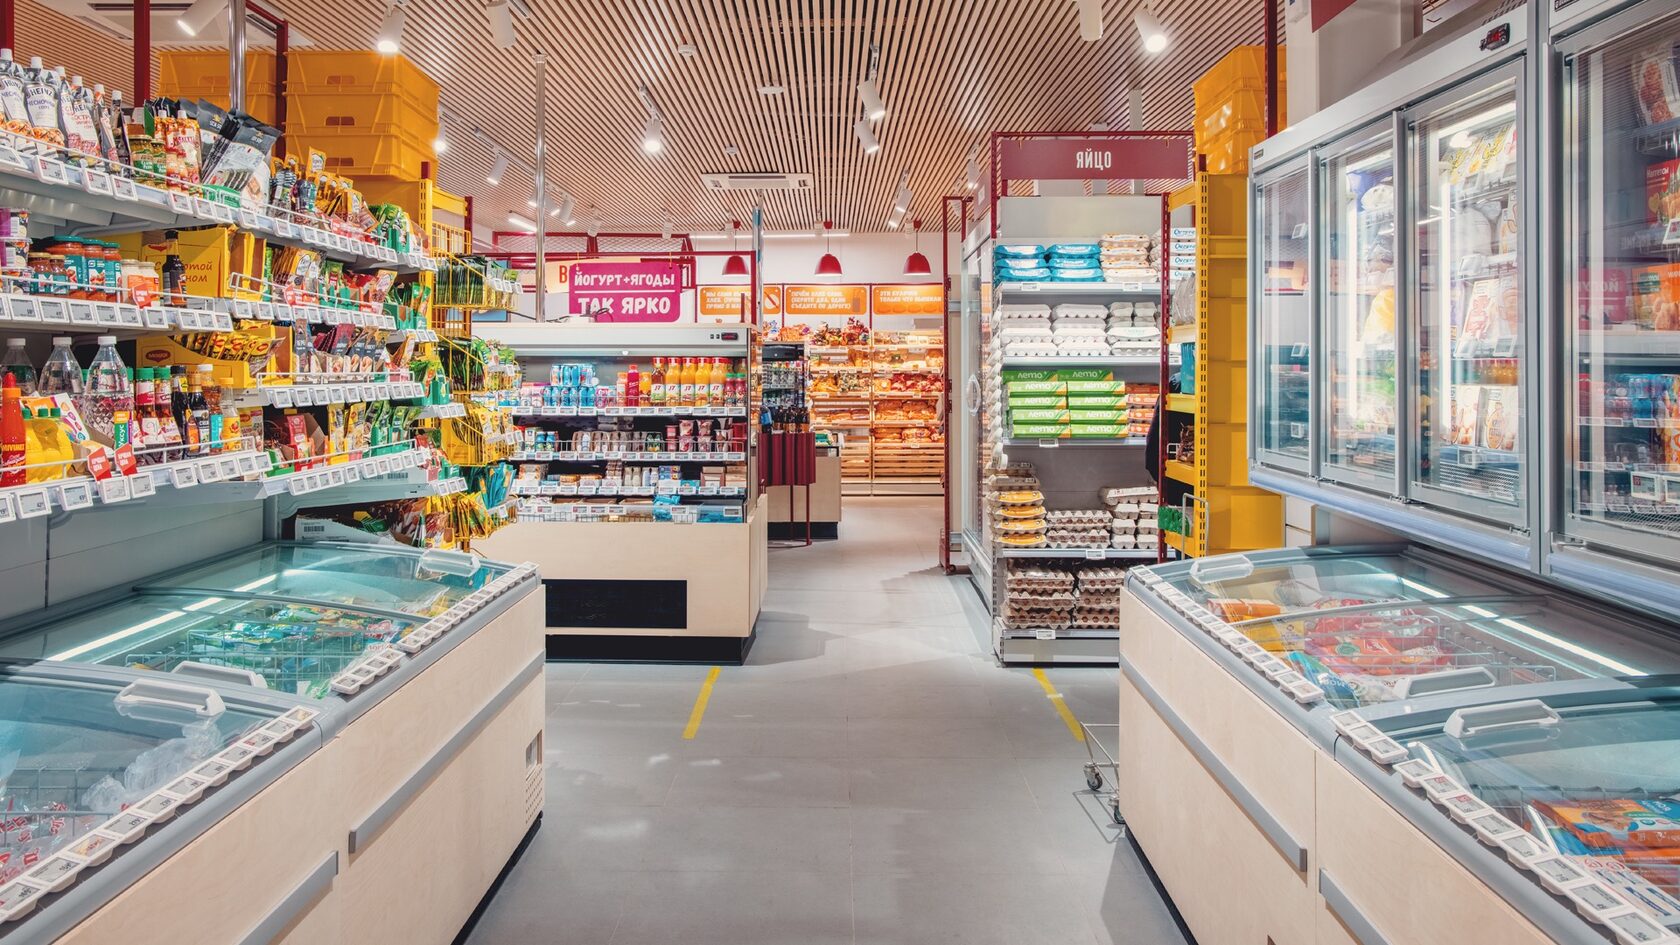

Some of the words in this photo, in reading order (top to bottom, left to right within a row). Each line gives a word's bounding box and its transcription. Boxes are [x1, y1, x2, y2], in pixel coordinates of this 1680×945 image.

[30, 87, 53, 97] HEINZ
[1076, 151, 1112, 170] ЯЙЦО
[574, 271, 675, 287] ЙОГУРТ+ЯГОДЫ
[578, 297, 614, 315] ТАК
[621, 297, 671, 315] ЯРКО
[118, 424, 126, 447] Уксус
